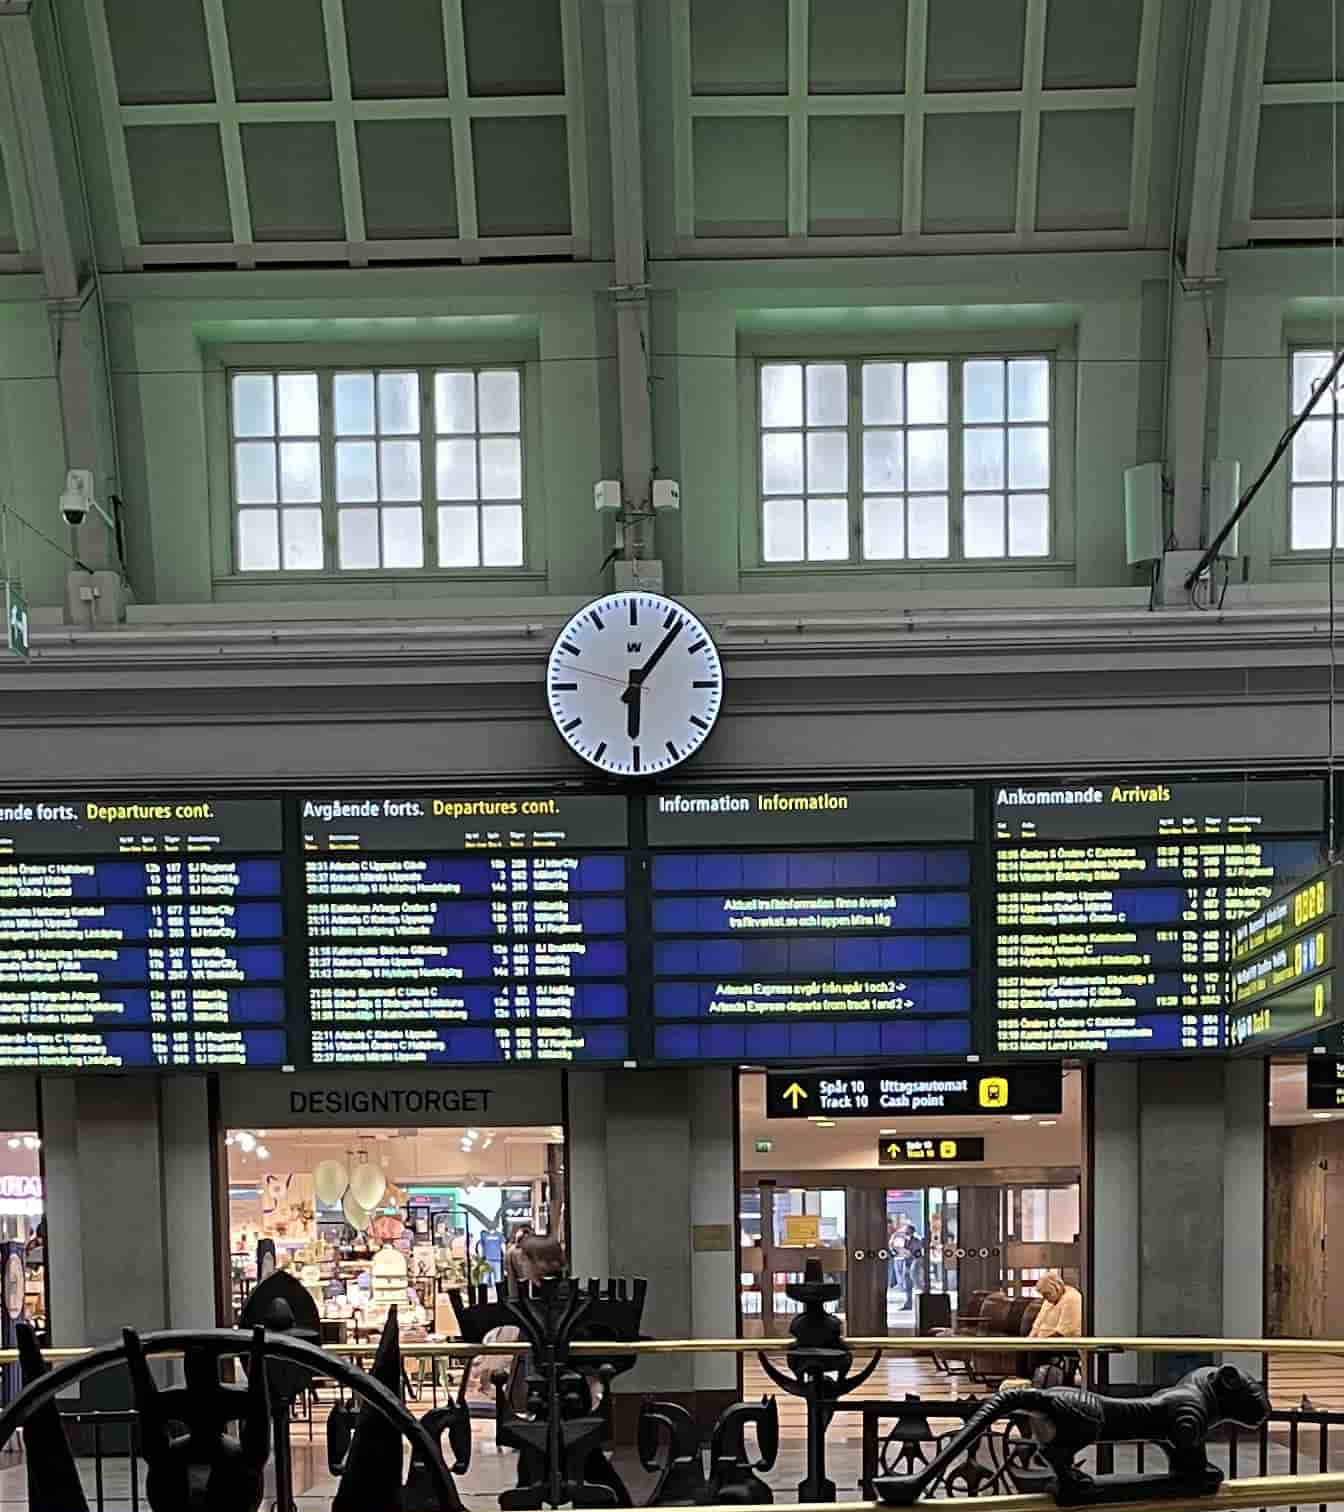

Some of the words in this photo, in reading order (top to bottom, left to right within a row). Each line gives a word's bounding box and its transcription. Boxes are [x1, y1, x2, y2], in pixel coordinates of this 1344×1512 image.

[659, 796, 749, 813] Information
[757, 794, 848, 811] Information
[997, 787, 1103, 805] Ankommande
[1111, 785, 1171, 803] Arrivals
[37, 804, 78, 821] forts.
[87, 804, 171, 823] Departures
[176, 803, 214, 819] cont.
[304, 800, 378, 820] Avgående
[383, 800, 424, 817] forts.
[433, 800, 516, 818] Departures
[521, 799, 559, 815] cont.
[819, 1080, 848, 1096] Spår
[851, 1080, 865, 1093] 10
[880, 1078, 968, 1095] Uttagsautomat
[289, 1089, 494, 1115] DESIGNTORGET
[820, 1095, 851, 1108] Track
[854, 1095, 869, 1108] 10
[880, 1094, 910, 1108] Cash
[912, 1094, 945, 1109] point
